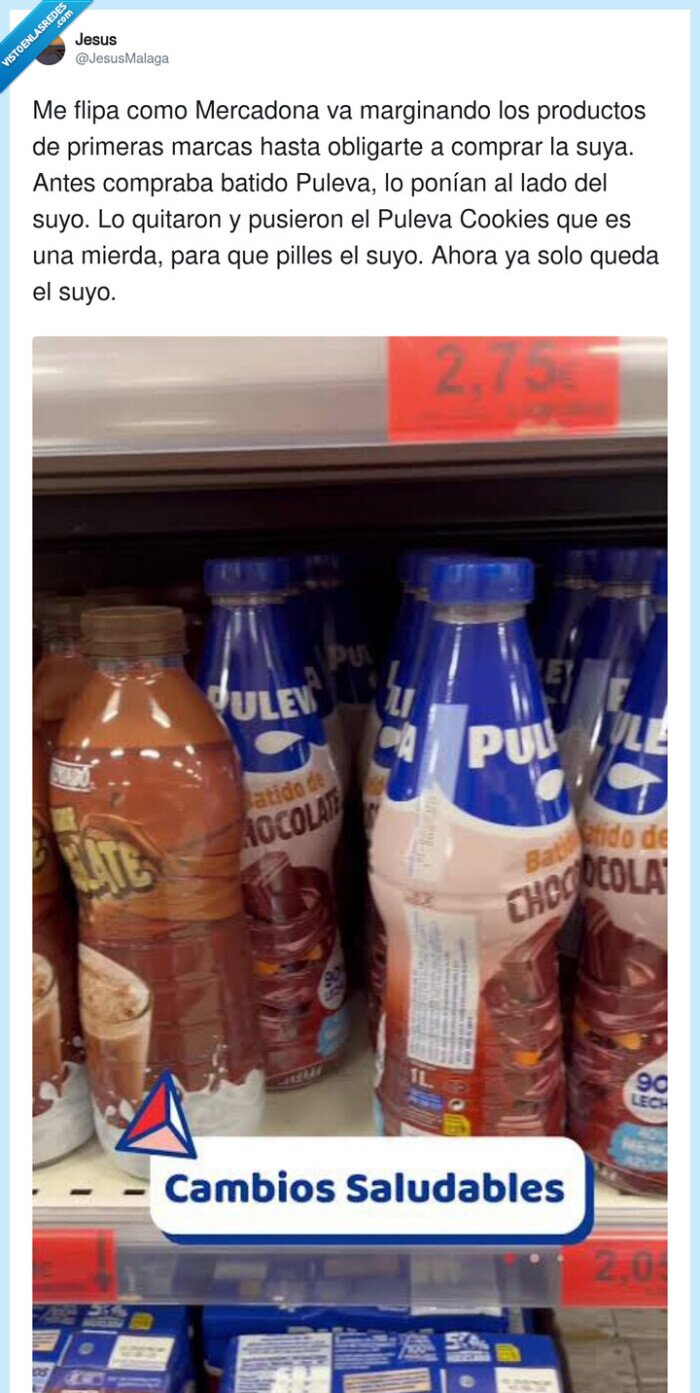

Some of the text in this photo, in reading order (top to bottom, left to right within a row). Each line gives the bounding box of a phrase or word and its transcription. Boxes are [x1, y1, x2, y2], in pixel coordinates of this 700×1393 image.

[208, 684, 317, 722] PULEV
[253, 781, 305, 810] atido
[245, 788, 341, 848] HOCOLATE
